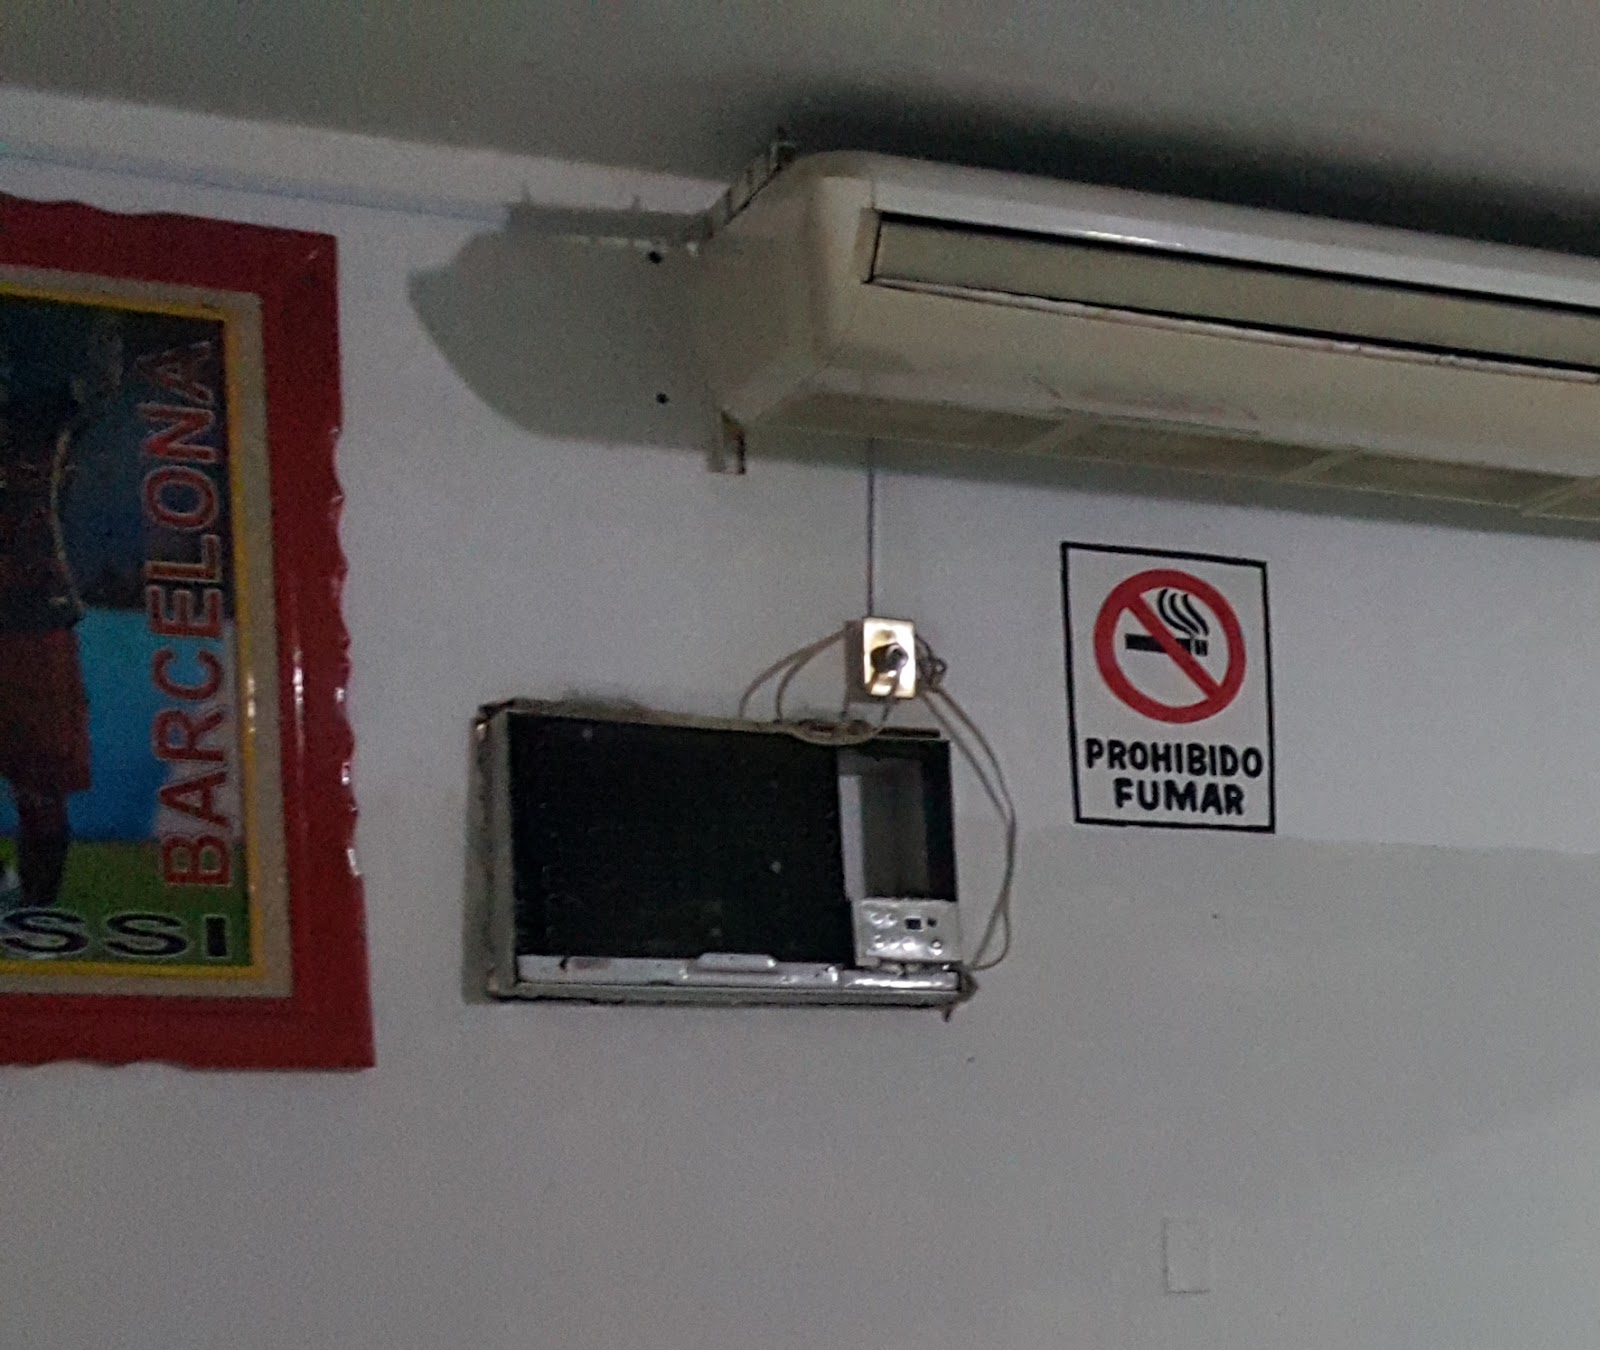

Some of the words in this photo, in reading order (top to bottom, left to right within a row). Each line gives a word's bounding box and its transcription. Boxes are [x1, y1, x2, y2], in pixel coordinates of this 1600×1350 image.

[135, 338, 233, 889] BARCELONA
[1084, 737, 1264, 779] PROHIBIDO
[1112, 777, 1245, 816] FUMAR
